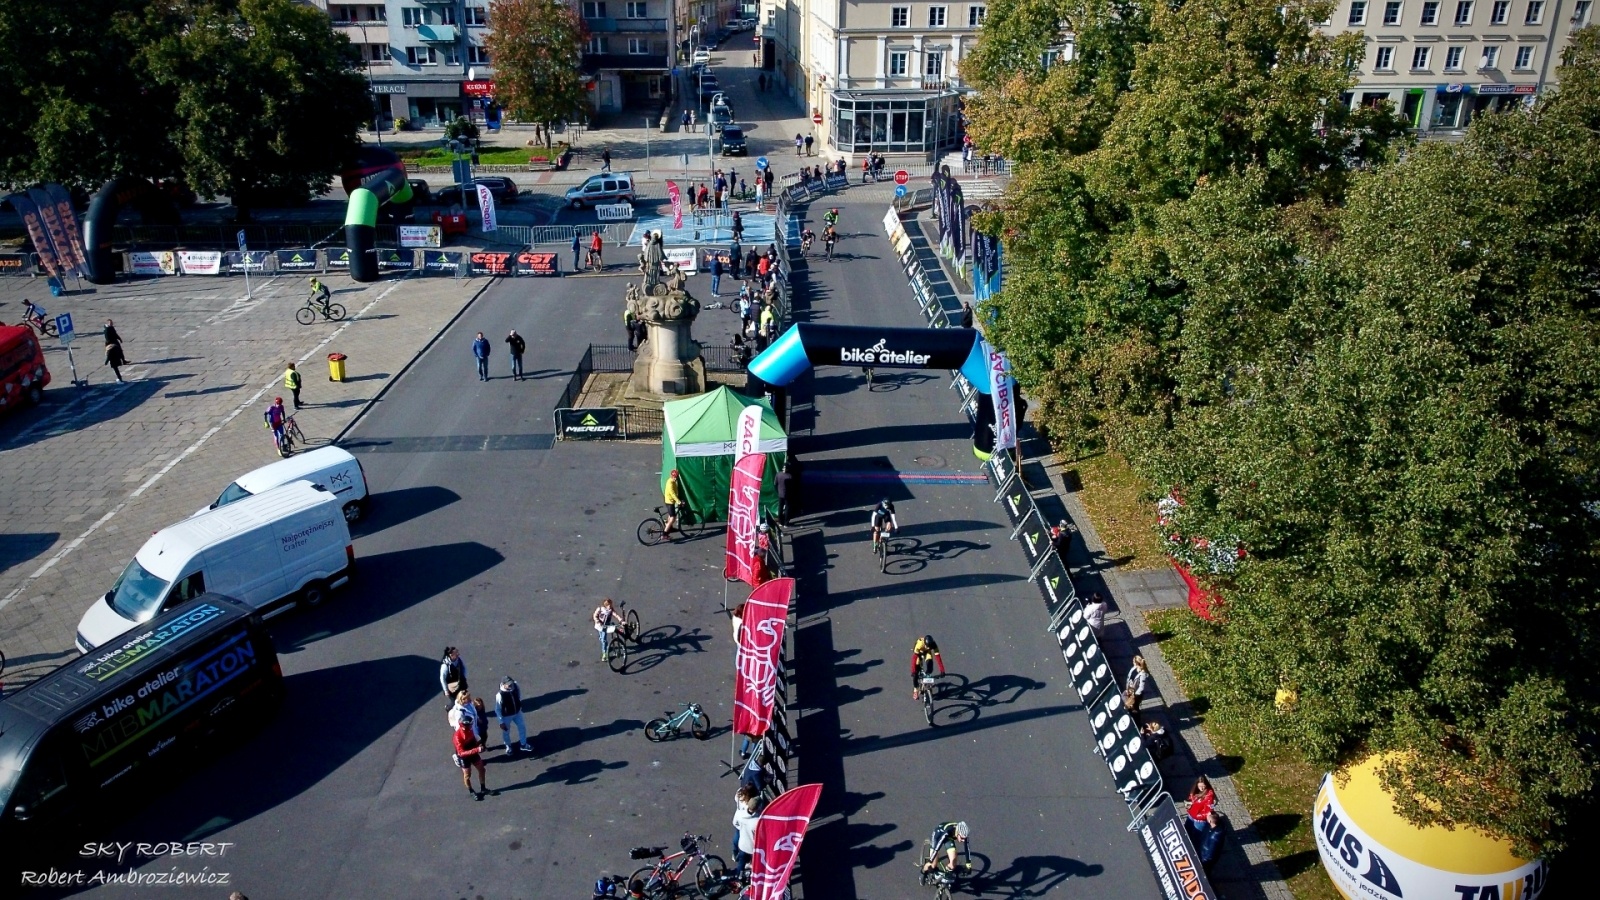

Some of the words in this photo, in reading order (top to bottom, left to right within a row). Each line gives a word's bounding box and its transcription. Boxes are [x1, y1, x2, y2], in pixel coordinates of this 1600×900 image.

[472, 253, 510, 264] CST
[518, 253, 556, 264] CST
[60, 316, 69, 332] P
[841, 347, 875, 363] bike
[879, 350, 931, 365] atelier
[281, 519, 335, 545] Najpotężniejszy
[283, 538, 308, 553] Crafter
[97, 646, 123, 664] bike
[122, 629, 154, 650] atelier
[102, 694, 136, 719] bike
[137, 665, 180, 698] atelier
